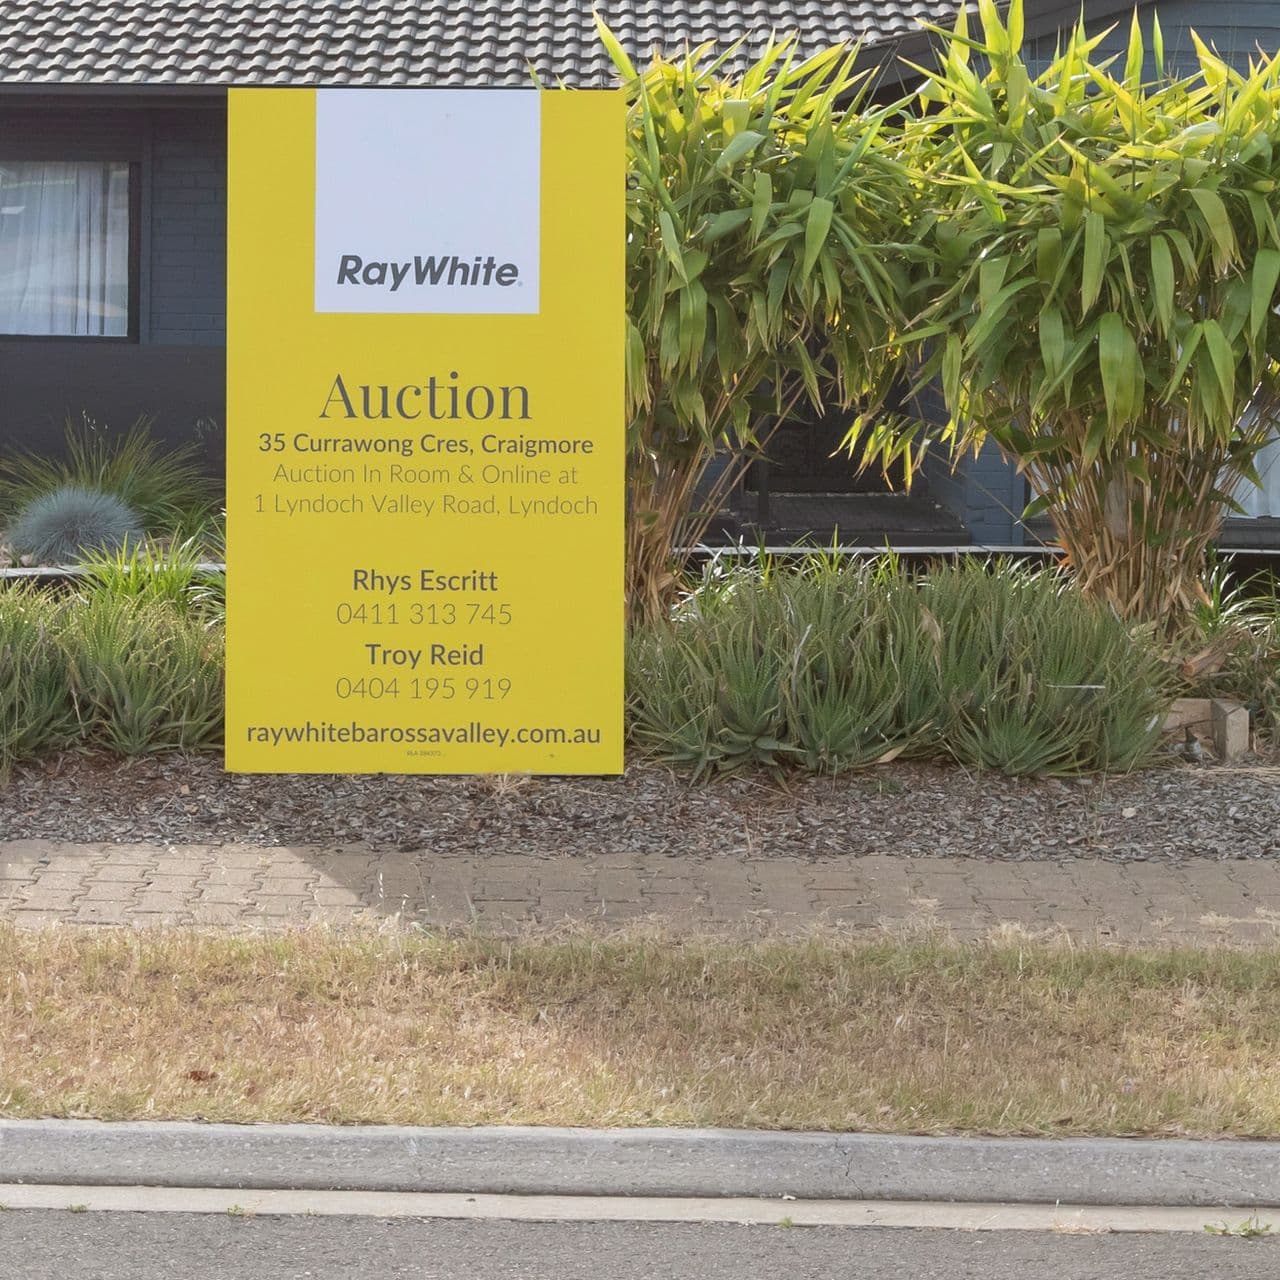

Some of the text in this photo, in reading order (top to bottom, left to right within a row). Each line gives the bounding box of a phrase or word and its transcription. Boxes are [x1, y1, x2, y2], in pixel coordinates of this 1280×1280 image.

[318, 370, 533, 421] Auction
[258, 432, 594, 458] 35 Currawong Cres, Craigmore
[272, 463, 579, 485] Auction In Room & Online at
[255, 493, 598, 519] 1 Lyndoch Valley Road, Lyndoch
[353, 569, 499, 595] Rhys Escritt
[336, 602, 513, 625] 0411 313 745
[364, 643, 484, 670] Troy Reid
[335, 677, 512, 700] 0404 195 919
[247, 721, 601, 748] raywhitebarossavalley.com.au
